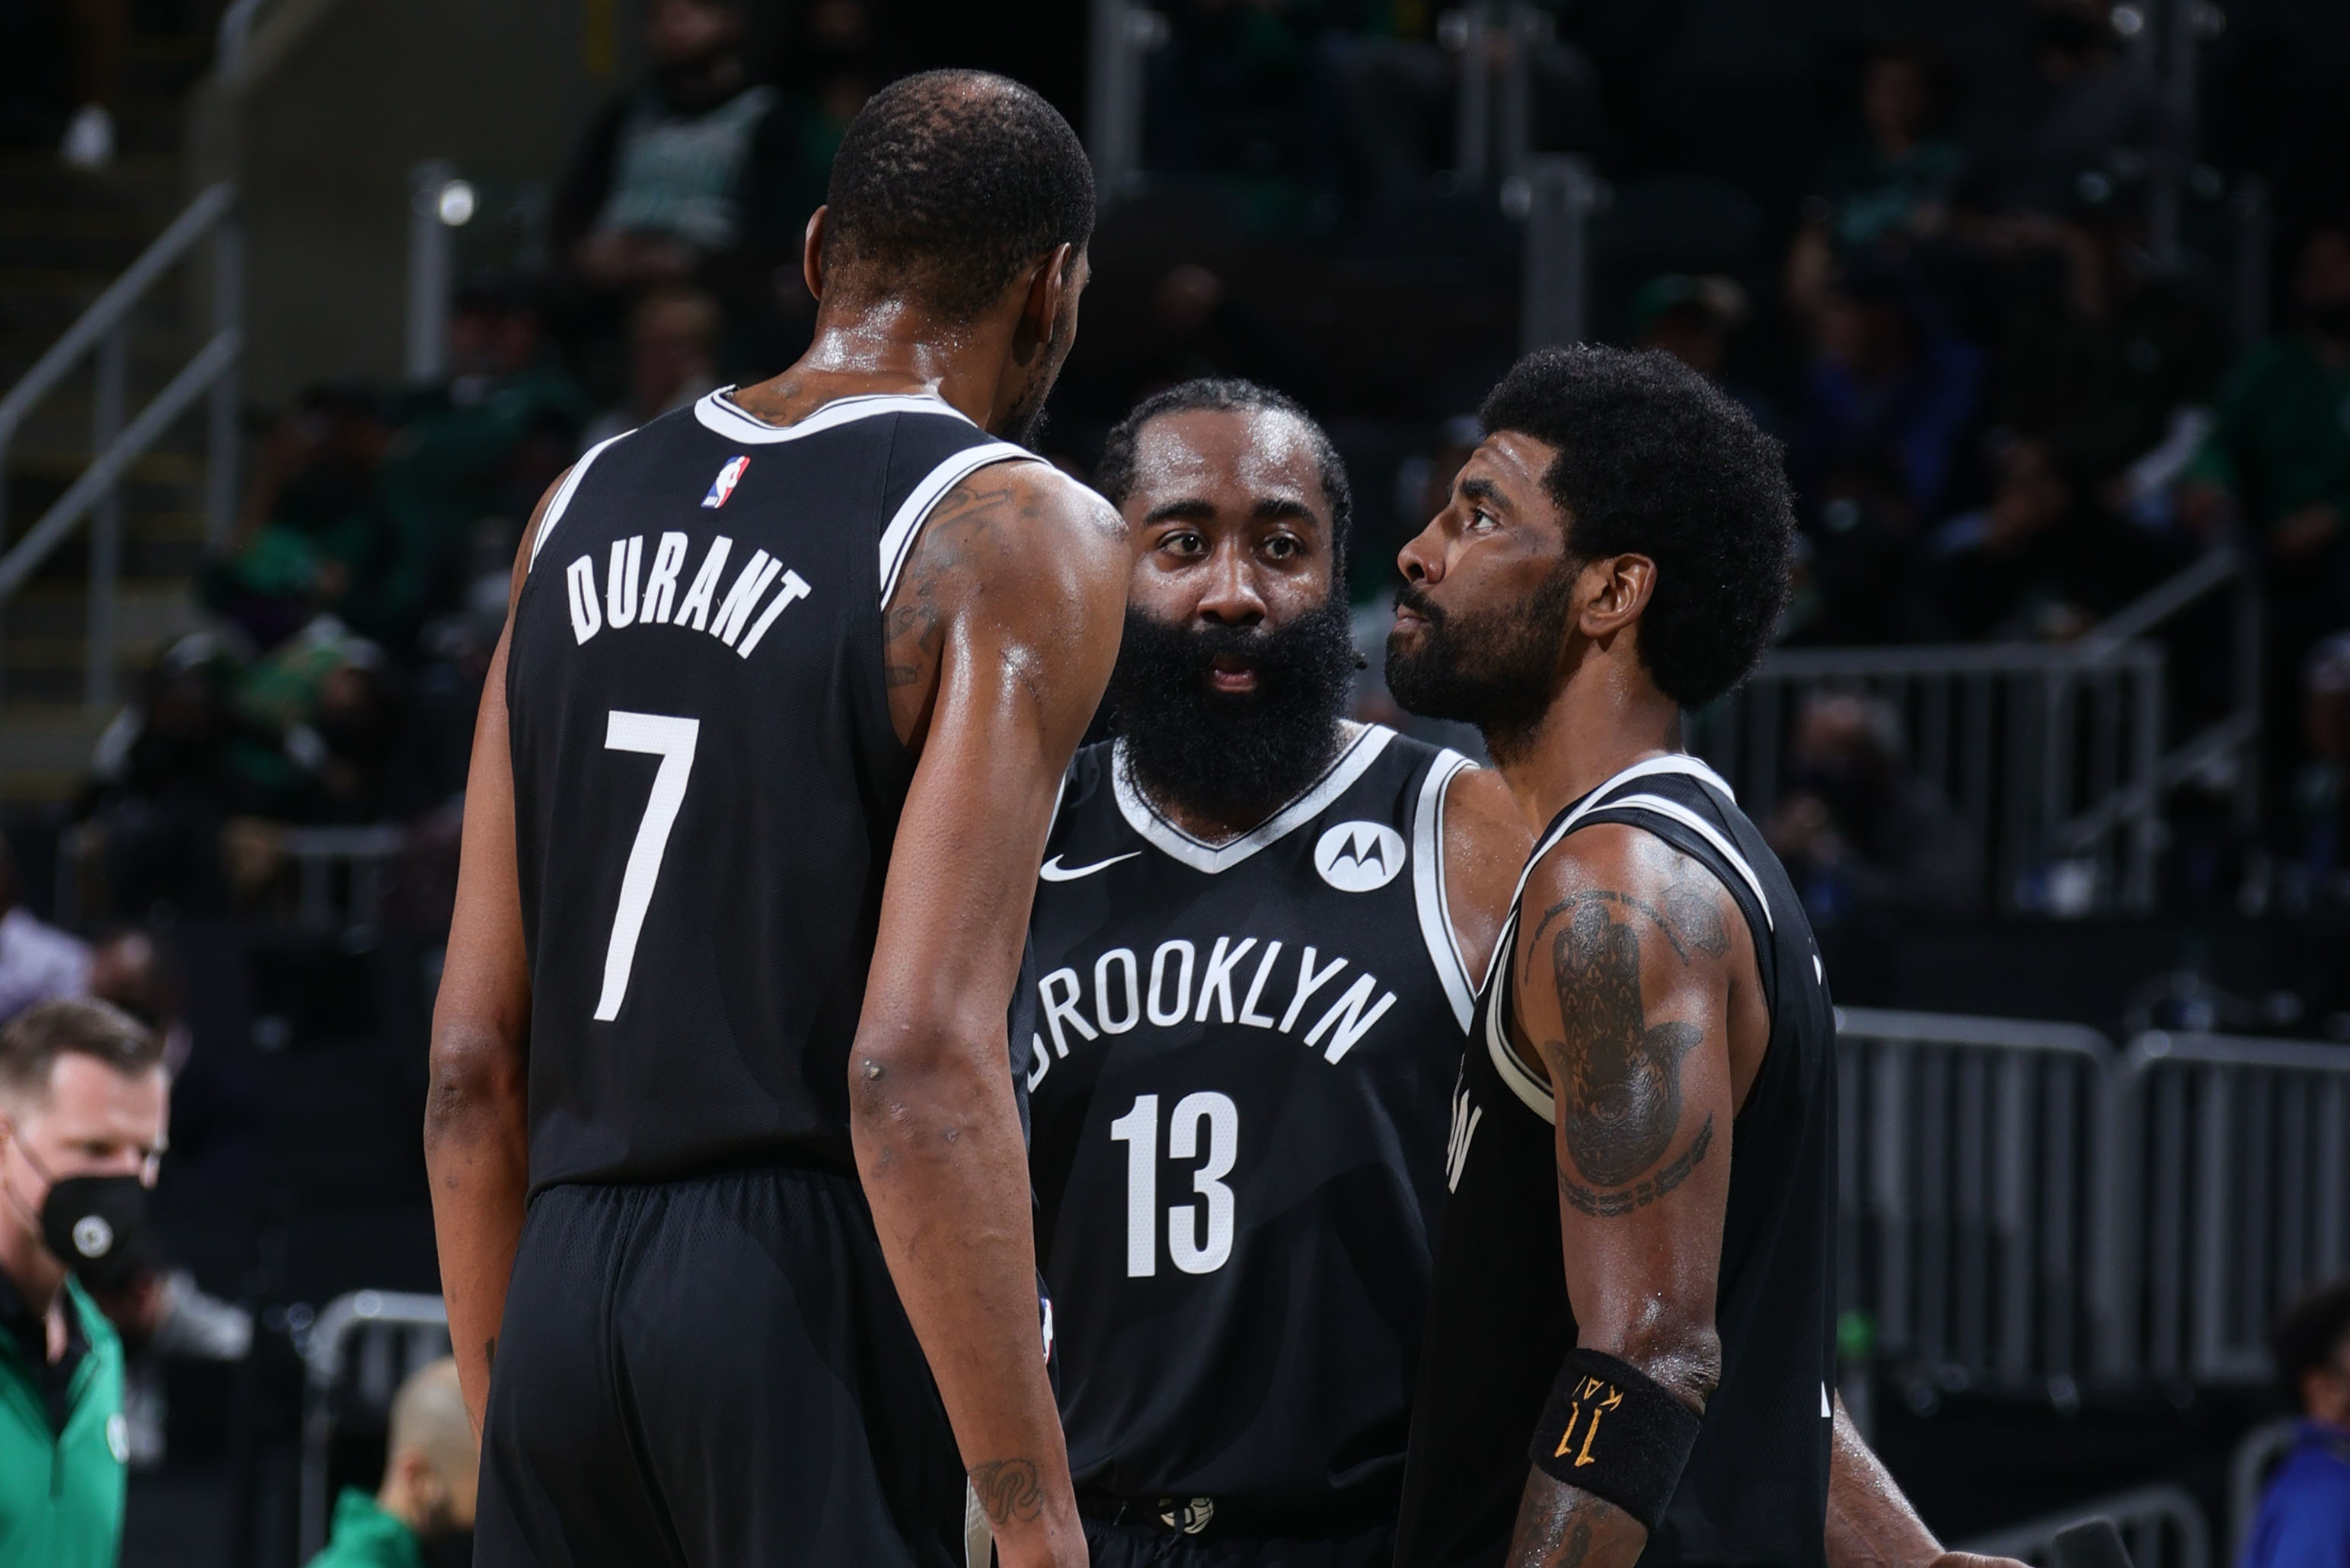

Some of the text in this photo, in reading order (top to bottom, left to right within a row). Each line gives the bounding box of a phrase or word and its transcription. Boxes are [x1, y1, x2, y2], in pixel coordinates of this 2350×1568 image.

[567, 531, 812, 659] DURANT
[594, 711, 700, 1022] 7
[1110, 1091, 1239, 1278] 13
[1554, 1401, 1602, 1467] 11
